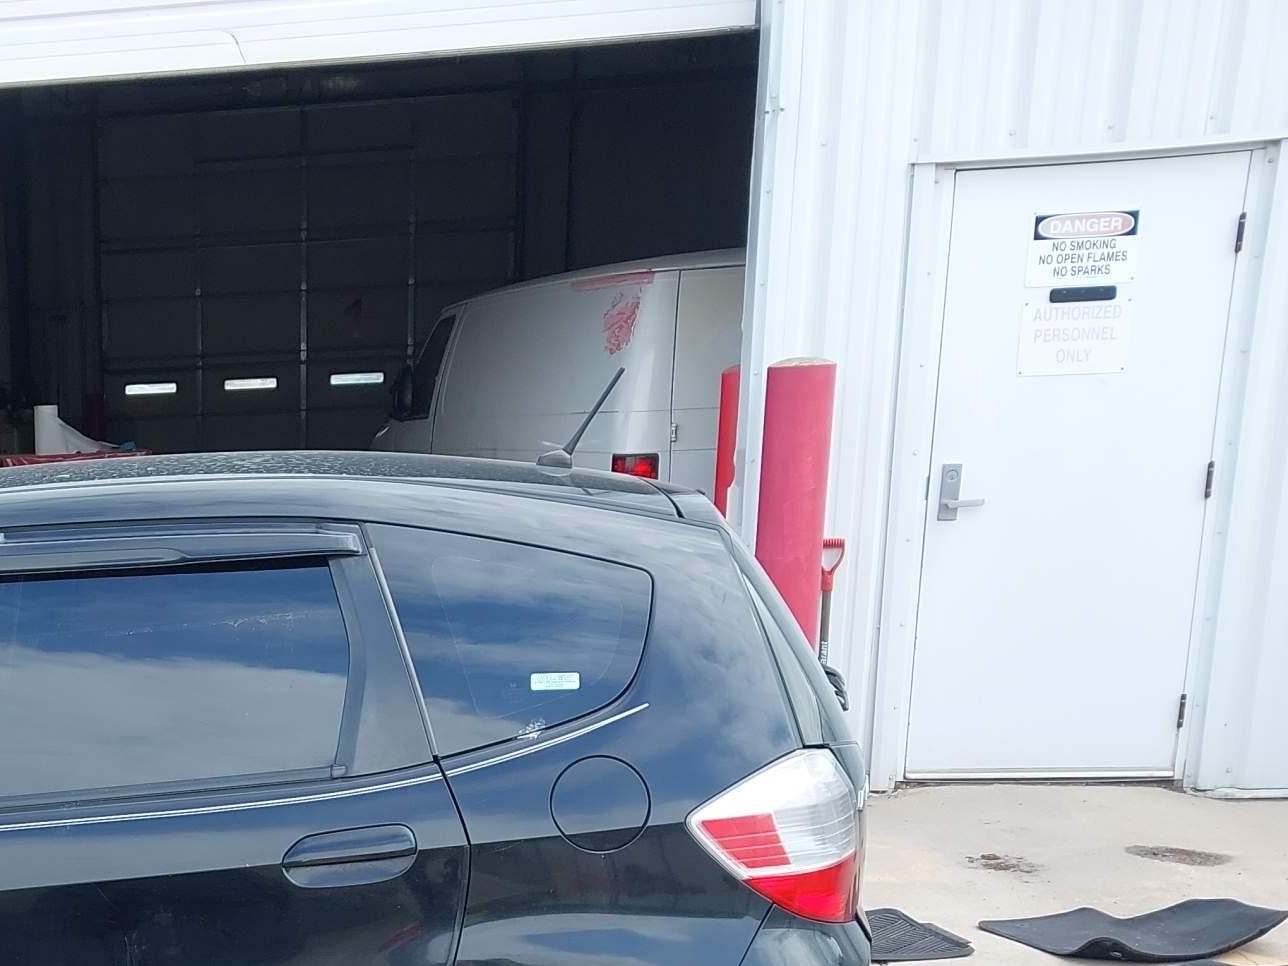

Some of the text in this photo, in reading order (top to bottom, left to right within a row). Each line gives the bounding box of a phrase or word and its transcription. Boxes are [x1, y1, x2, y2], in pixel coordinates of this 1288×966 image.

[1050, 217, 1122, 233] DANGER
[1052, 238, 1117, 252] NO SMOKING
[1038, 250, 1128, 265] NO OPEN FLAMES
[1053, 264, 1111, 277] NO SPARKS
[1033, 304, 1122, 322] AUTHORIZED
[1033, 326, 1117, 343] PERSONNEL
[1055, 348, 1092, 364] ONLY
